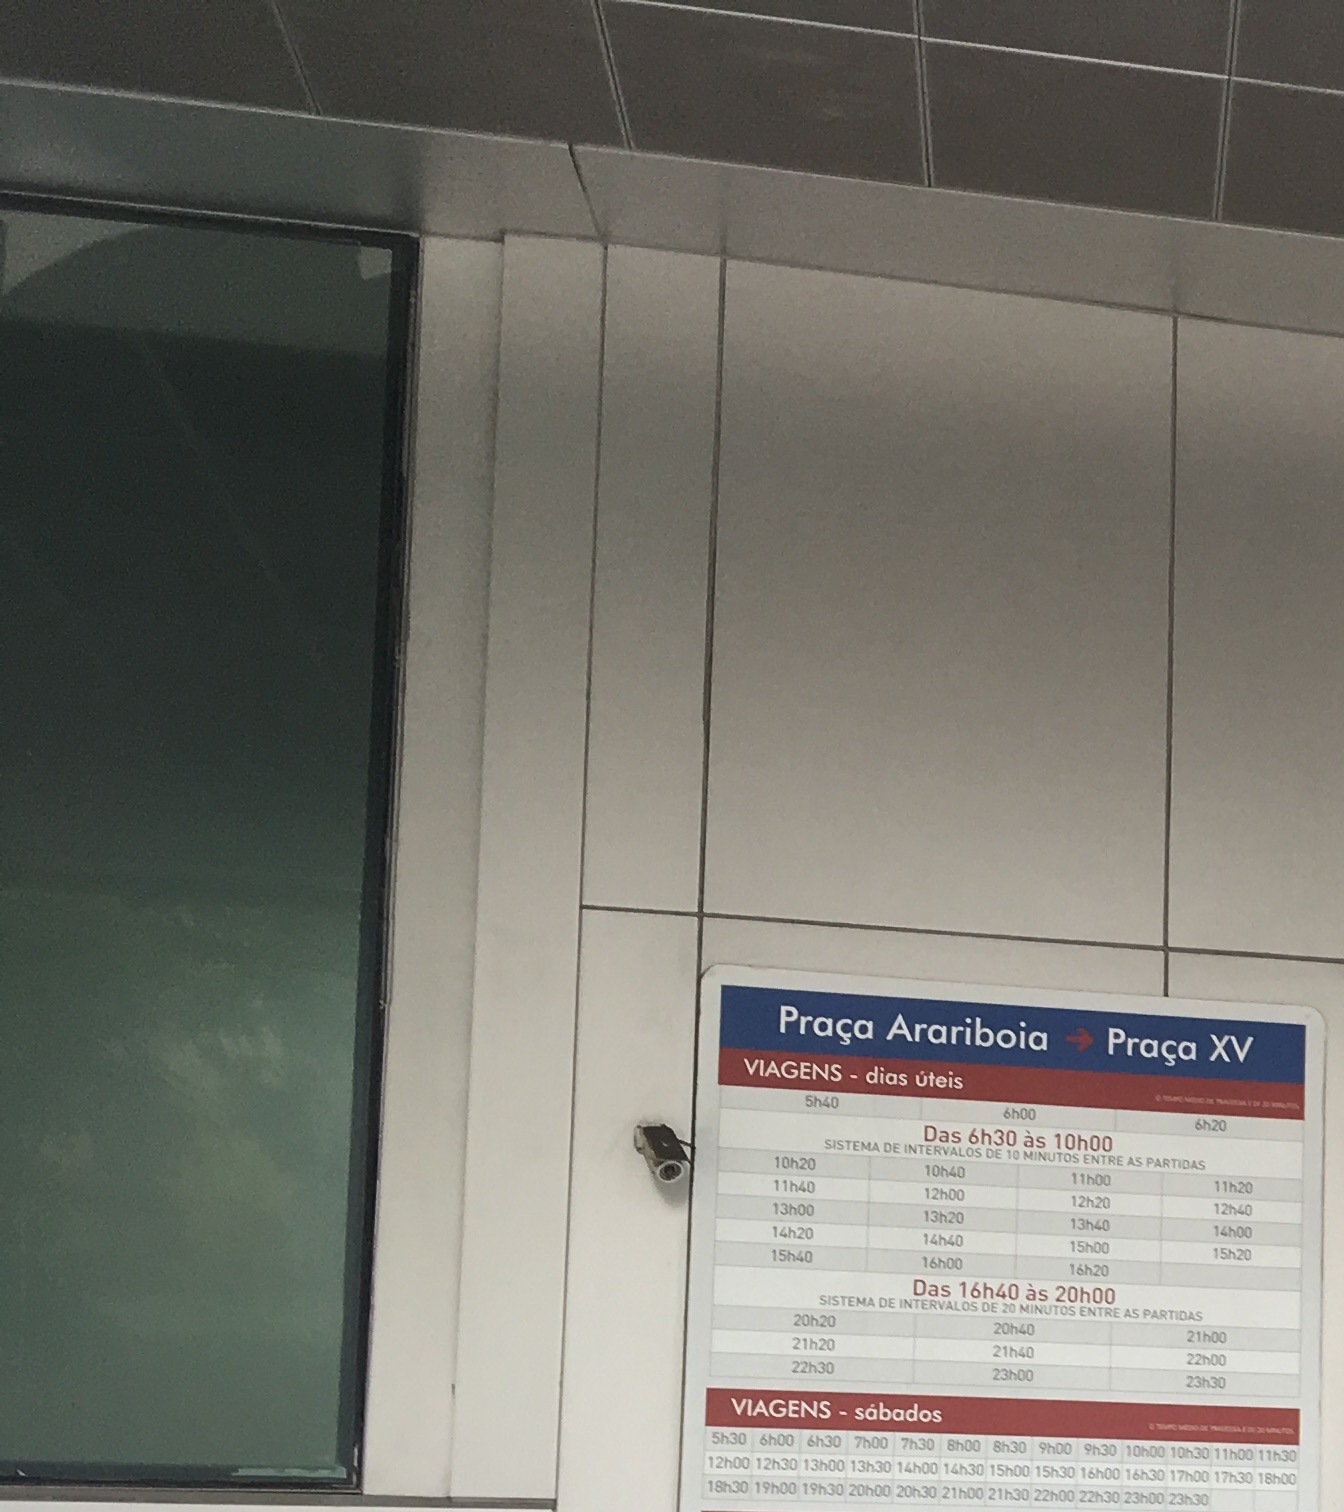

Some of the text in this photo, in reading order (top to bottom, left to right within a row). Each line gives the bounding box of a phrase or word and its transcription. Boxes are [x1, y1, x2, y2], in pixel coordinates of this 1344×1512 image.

[779, 1005, 1254, 1067] Praça Arariboia Praça XV
[743, 1058, 843, 1082] VIAGENS
[865, 1065, 908, 1087] dias
[915, 1070, 964, 1090] úteis
[804, 1094, 1227, 1133] 5h40 6h00 6h20
[824, 1138, 881, 1153] SISTEMA
[883, 1142, 901, 1154] DE
[904, 1143, 983, 1159] INTERVALOS
[985, 1147, 1002, 1160] DE
[1023, 1150, 1080, 1164] MINUTOS
[1082, 1153, 1124, 1167] ENTRE
[1126, 1156, 1144, 1168] AS
[1145, 1157, 1206, 1171] PARTIDAS
[923, 1125, 1113, 1153] Das 6h30 às 10h00
[774, 1155, 1254, 1195] 10h20 10h40 11h00 11h20
[773, 1179, 1253, 1217] 11h40 12h00 12h20 12h40
[772, 1202, 1253, 1240] 13h00 13h20 13h40 14h00
[772, 1225, 1252, 1262] 14h20 14h40 15h00 15h20
[771, 1248, 1110, 1278] 15h40 16h00 16h20
[913, 1278, 1116, 1305] Das 16h40 às 20h00
[819, 1294, 876, 1308] SISTEMA
[878, 1296, 896, 1309] DE
[899, 1298, 978, 1312] INTERVALOS
[981, 1301, 998, 1314] DE
[1019, 1303, 1076, 1317] MINUTOS
[1079, 1305, 1120, 1319] ENTRE
[1123, 1308, 1140, 1319] AS
[1142, 1308, 1204, 1322] PARTIDAS
[793, 1313, 1227, 1344] 20h20 20h40 21h00
[792, 1336, 1227, 1367] 21h20 21h40 22h00
[791, 1360, 1227, 1390] 22h30 23h00 23h30
[730, 1397, 832, 1419] VIAGENS
[854, 1401, 943, 1423] sábados
[711, 1431, 981, 1453] 5h30 6h00 6h30 7h00 7h30 8h00
